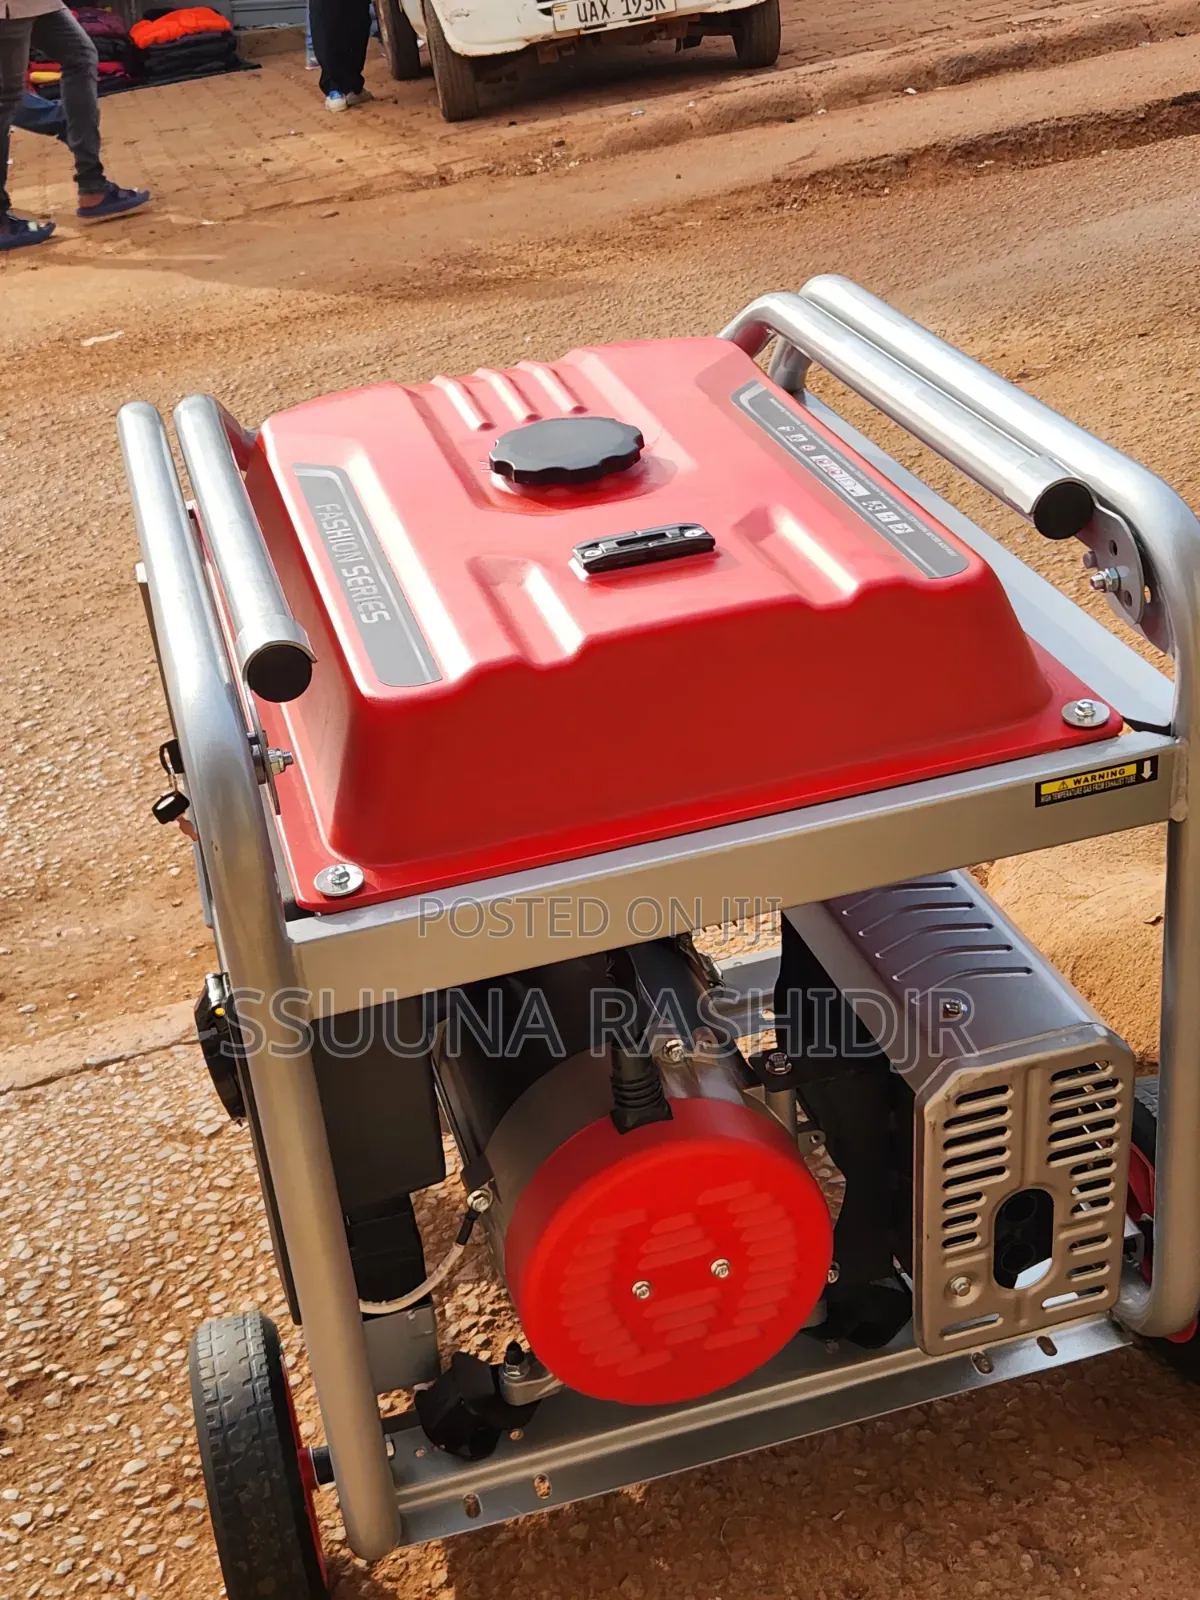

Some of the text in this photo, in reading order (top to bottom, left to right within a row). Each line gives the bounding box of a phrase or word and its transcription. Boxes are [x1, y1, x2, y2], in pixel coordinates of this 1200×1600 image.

[576, 0, 610, 22] UAX
[314, 503, 391, 624] FASHION SERIES
[1073, 768, 1126, 786] WARNING
[1052, 788, 1083, 800] TEMPERATURE
[1083, 786, 1092, 794] GAS
[1093, 783, 1105, 791] FROM
